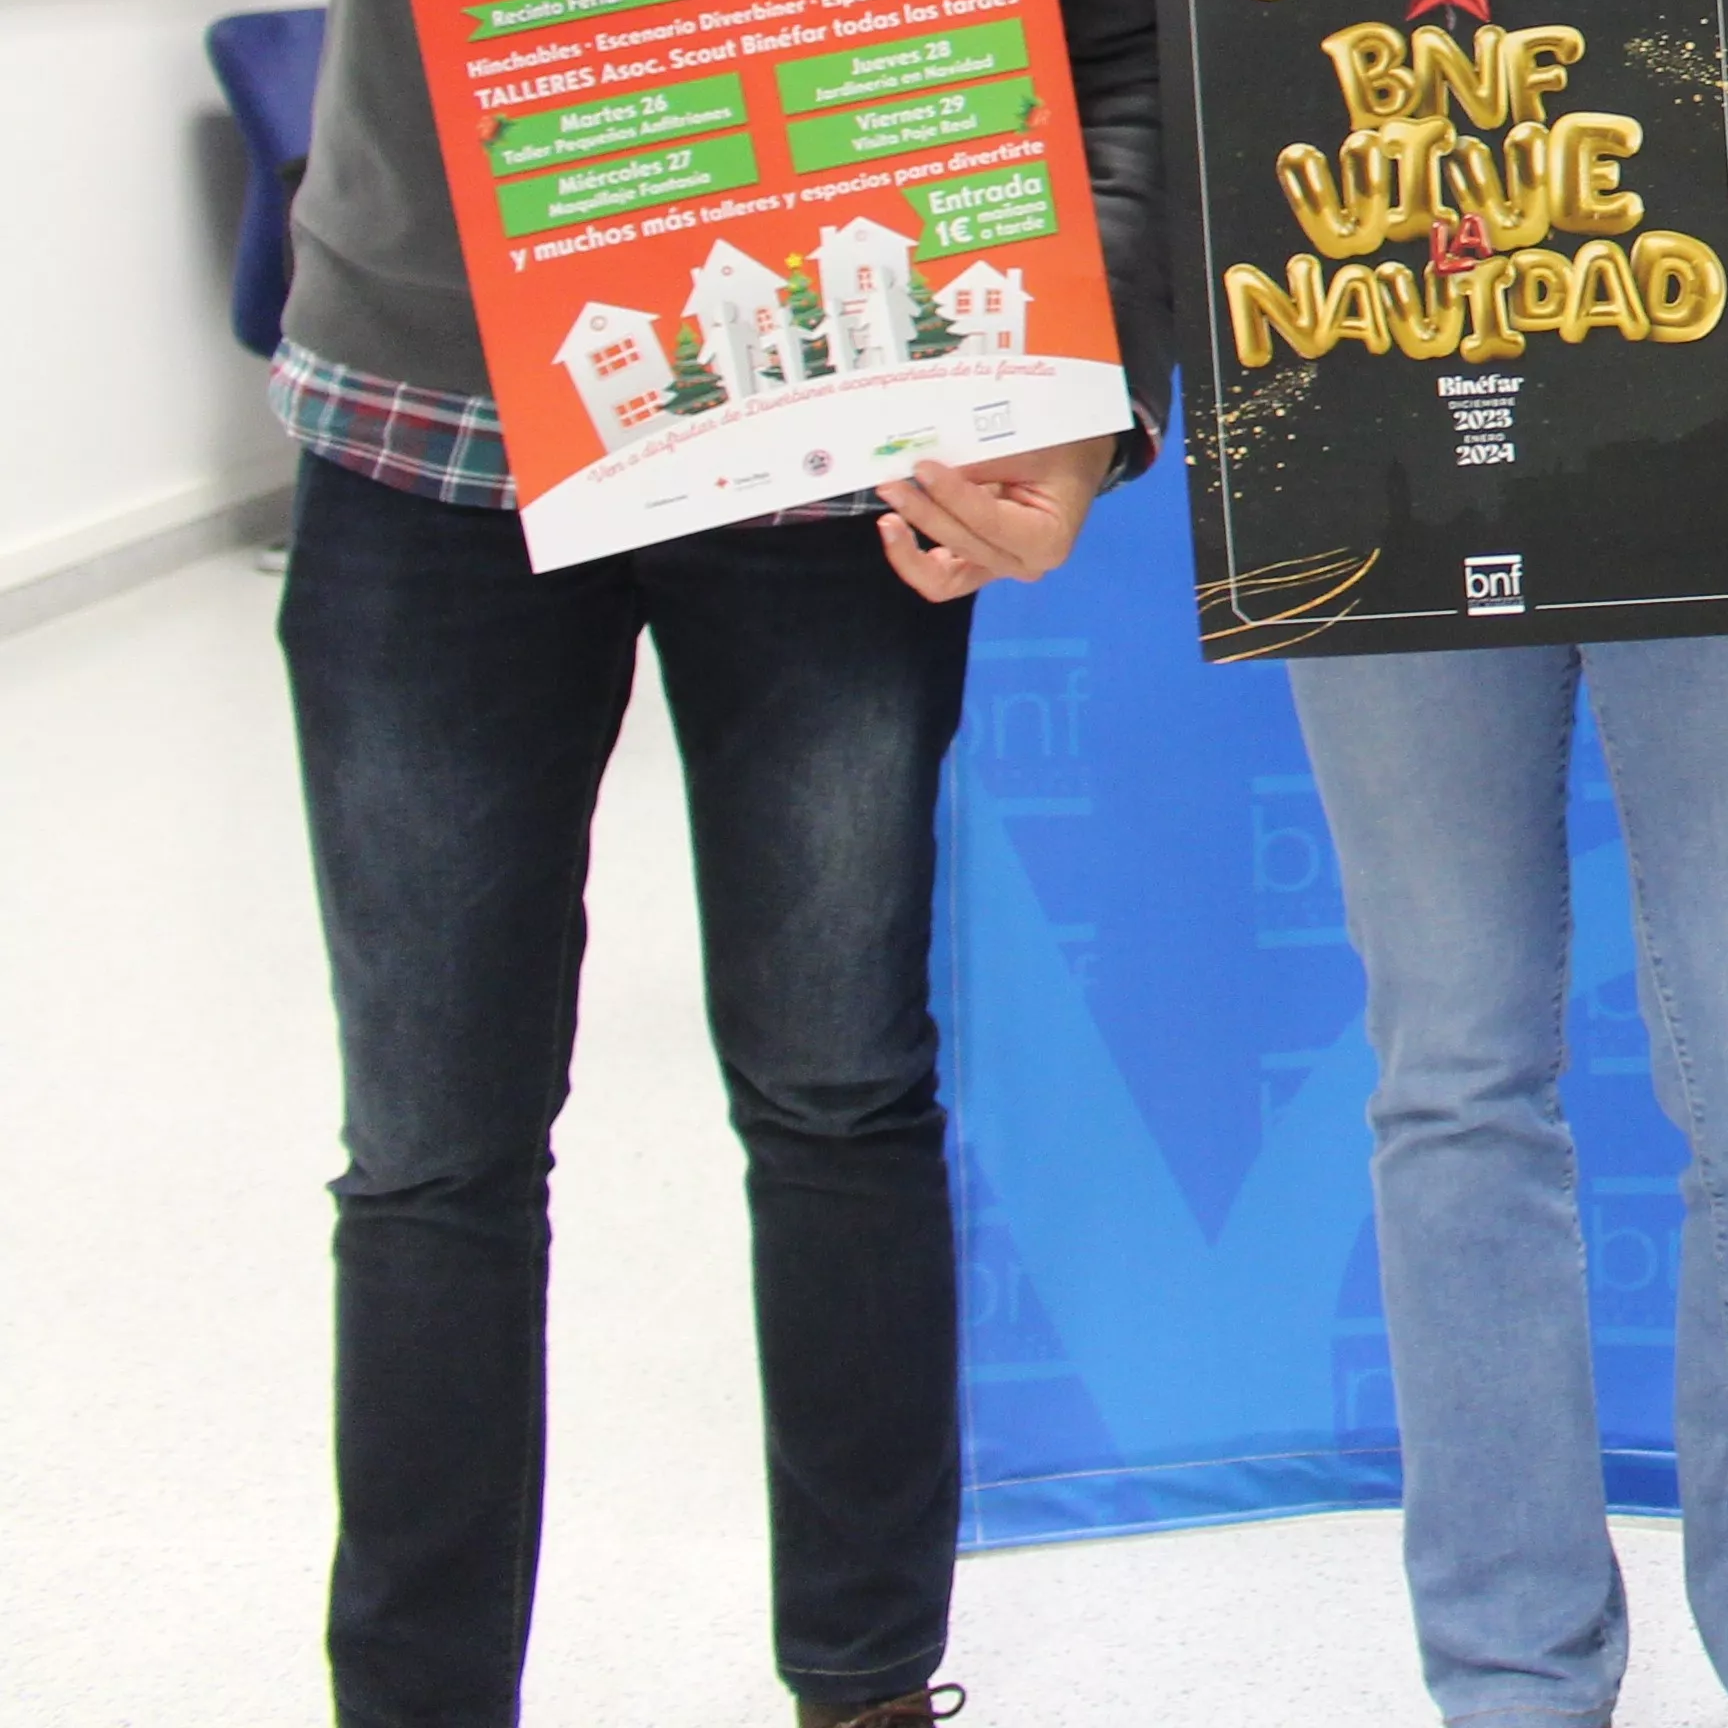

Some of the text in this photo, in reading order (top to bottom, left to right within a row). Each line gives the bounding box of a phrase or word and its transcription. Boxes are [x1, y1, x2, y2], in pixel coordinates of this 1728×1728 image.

[473, 67, 596, 109] TALLERES
[601, 58, 666, 84] Asoc.
[668, 39, 737, 69] Scout
[740, 24, 828, 55] Binéfar
[832, 11, 901, 37] todas
[903, 3, 940, 24] las
[1321, 21, 1587, 132] BNF
[509, 140, 1045, 272] y muchos más talleres y espacios para divertirte
[928, 172, 1045, 215] Entrada
[1277, 110, 1645, 260] VIVE
[934, 215, 975, 248] 1€
[979, 214, 1046, 240] o tarde
[1430, 213, 1493, 275] LA
[1224, 230, 1728, 368] NAVIDAD
[1437, 373, 1525, 397] Binéfar
[1453, 408, 1513, 431] 2023
[1455, 442, 1515, 466] 2024
[1464, 564, 1523, 602] bnf
